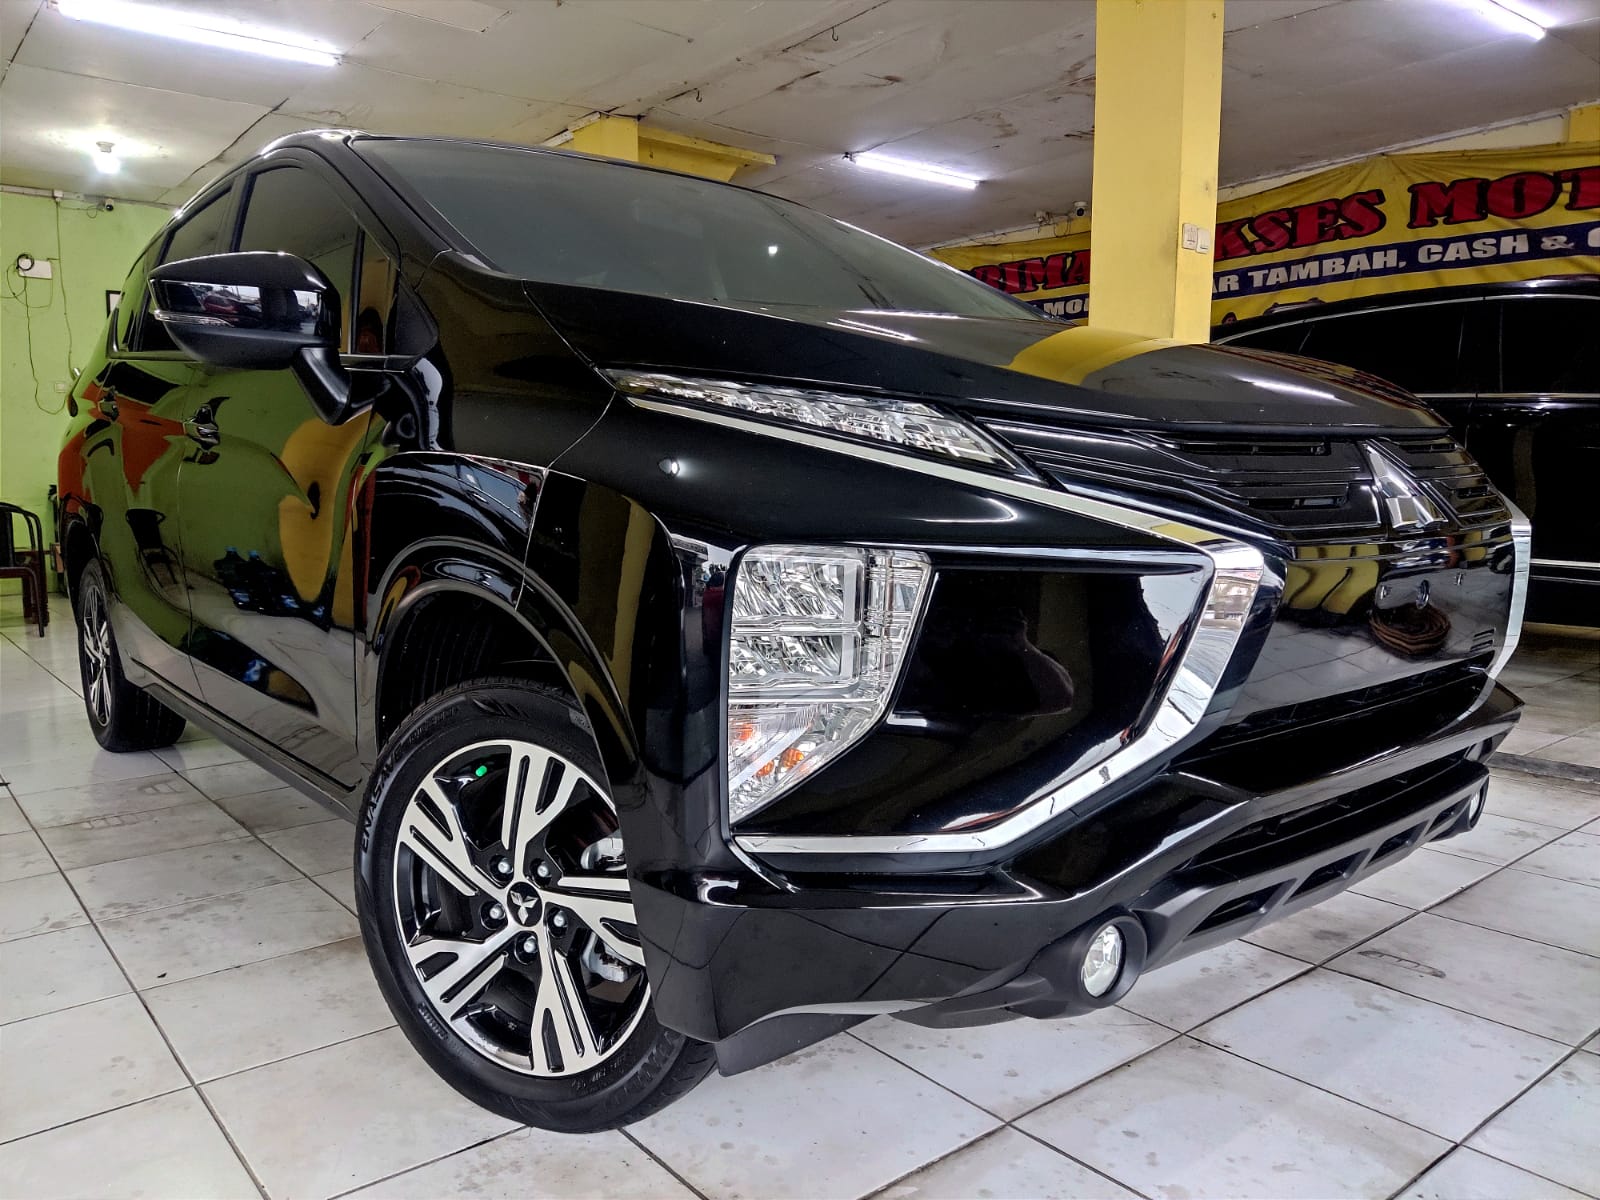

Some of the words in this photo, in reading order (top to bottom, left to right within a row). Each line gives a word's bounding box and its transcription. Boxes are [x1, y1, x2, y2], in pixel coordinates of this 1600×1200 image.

[962, 249, 1091, 294] RIMA
[1043, 298, 1089, 316] MO
[1247, 249, 1407, 288] TAMBAH,
[1417, 233, 1529, 264] CASH
[1540, 234, 1576, 251] &
